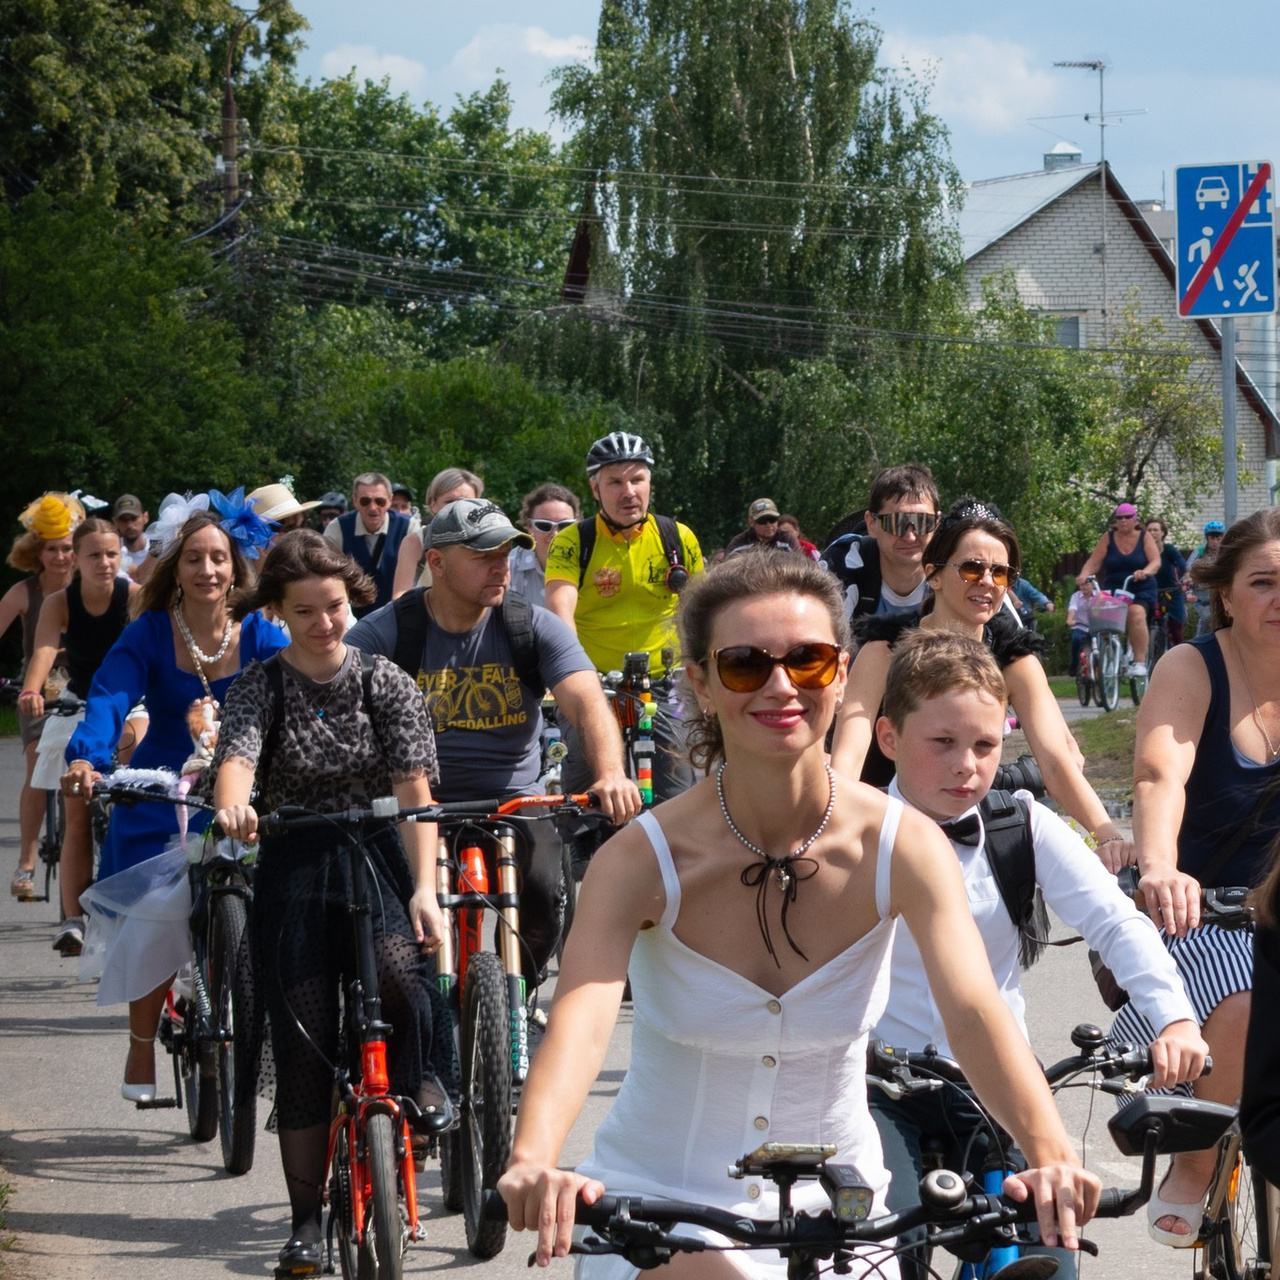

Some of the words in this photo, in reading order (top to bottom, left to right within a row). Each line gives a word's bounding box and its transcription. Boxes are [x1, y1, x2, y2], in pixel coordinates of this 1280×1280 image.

[416, 671, 457, 691] EVER
[482, 667, 520, 683] FALL
[447, 711, 527, 730] PEDALLING
[511, 1010, 520, 1071] ENERGY
